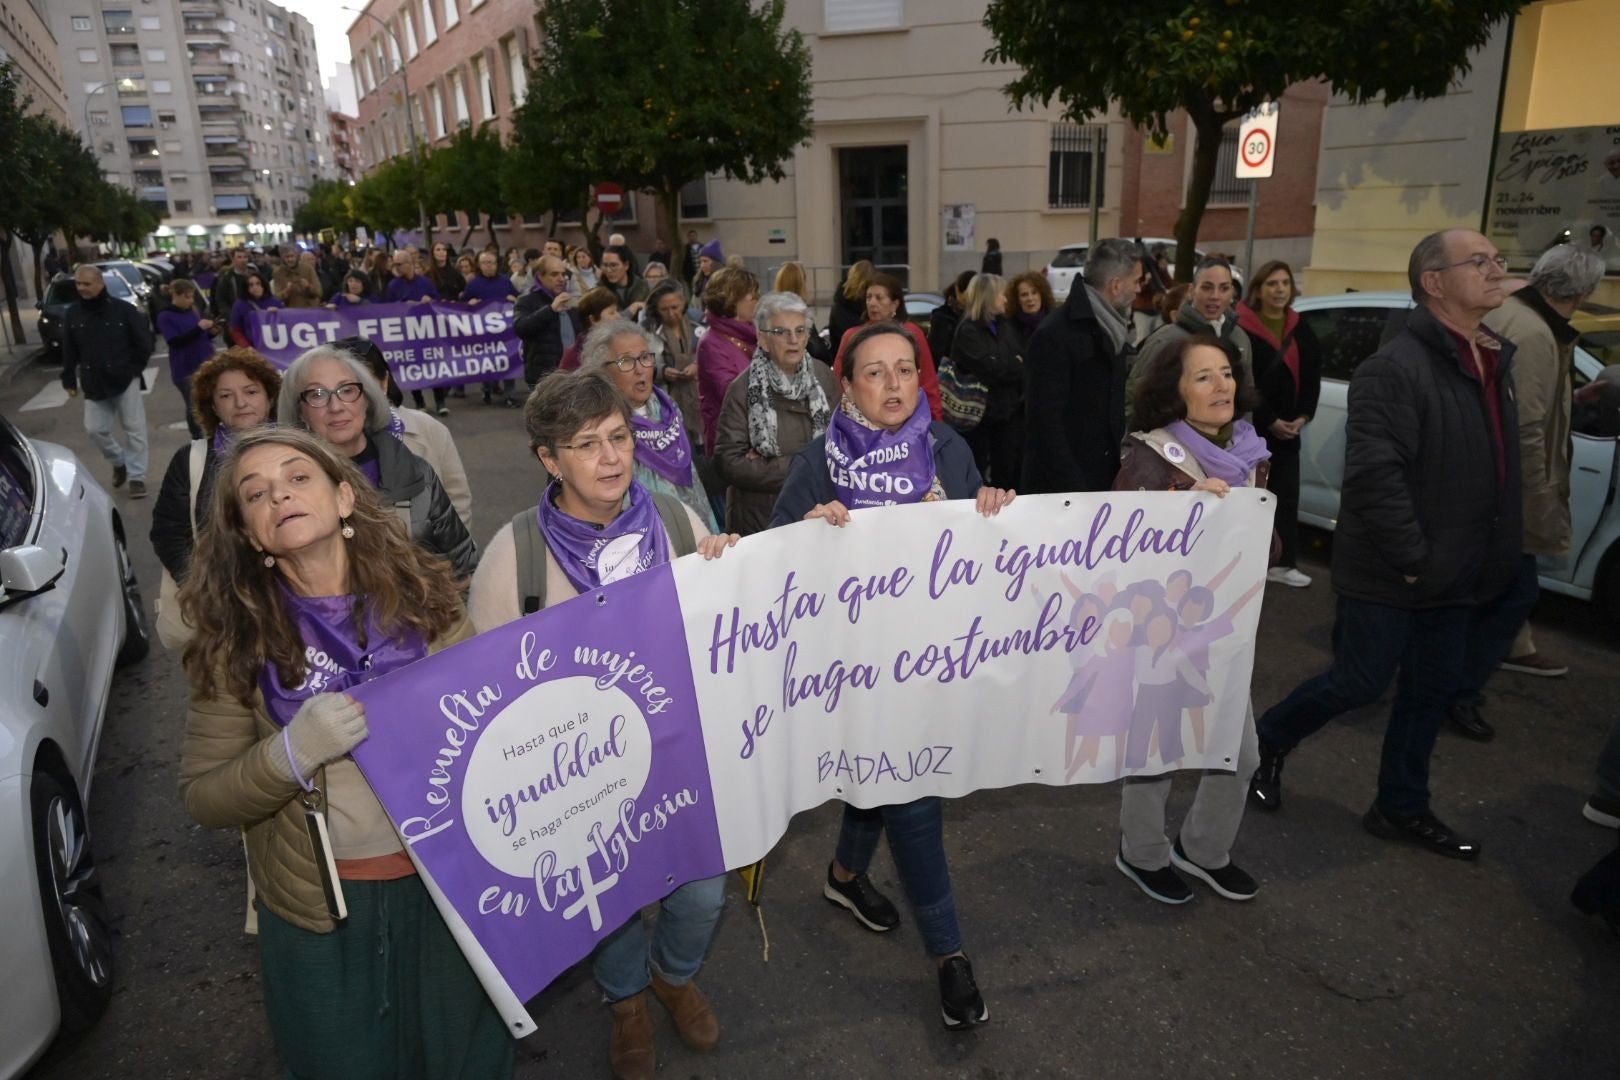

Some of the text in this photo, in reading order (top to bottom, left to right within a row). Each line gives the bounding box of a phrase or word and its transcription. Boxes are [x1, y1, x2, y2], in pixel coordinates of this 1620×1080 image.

[1247, 142, 1265, 155] 30
[1496, 205, 1561, 215] noviembre
[261, 321, 341, 350] UGT
[382, 340, 508, 363] PRE EN LUCHA
[399, 354, 510, 383] IGUALDAD
[868, 442, 909, 465] TODAS
[708, 503, 1204, 674] Hasta que la igualdad
[739, 592, 1103, 760] se haga costumbre
[400, 631, 673, 845] Revuelta de mujeres
[502, 712, 590, 761] Hasta que la
[484, 714, 627, 837] igualdad
[817, 746, 953, 784] BADAJOZ
[512, 777, 628, 851] se haga costumbre
[478, 788, 699, 917] en la Iglesia
